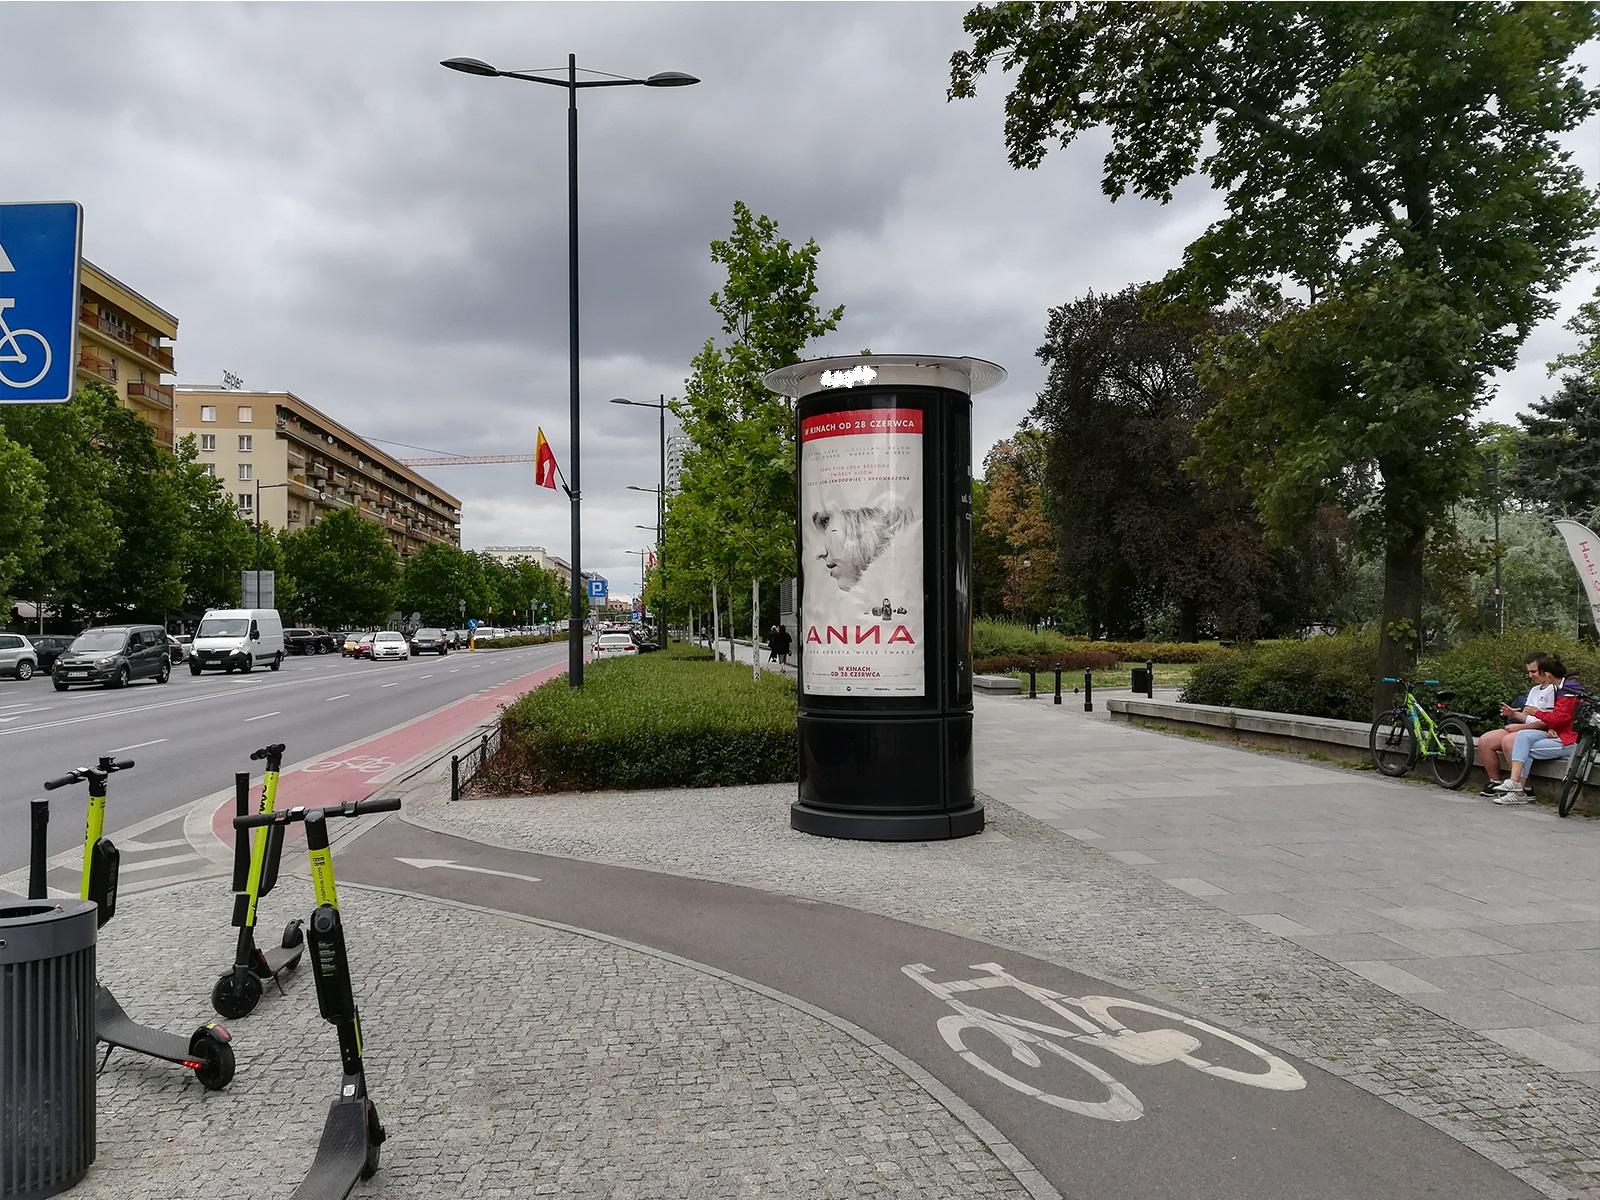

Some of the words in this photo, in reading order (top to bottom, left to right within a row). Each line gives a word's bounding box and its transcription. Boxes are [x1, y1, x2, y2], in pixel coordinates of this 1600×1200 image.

[809, 424, 836, 433] KINACH
[838, 422, 852, 430] OD
[854, 421, 867, 429] 28
[869, 420, 915, 428] CZERWCA
[592, 582, 603, 596] P
